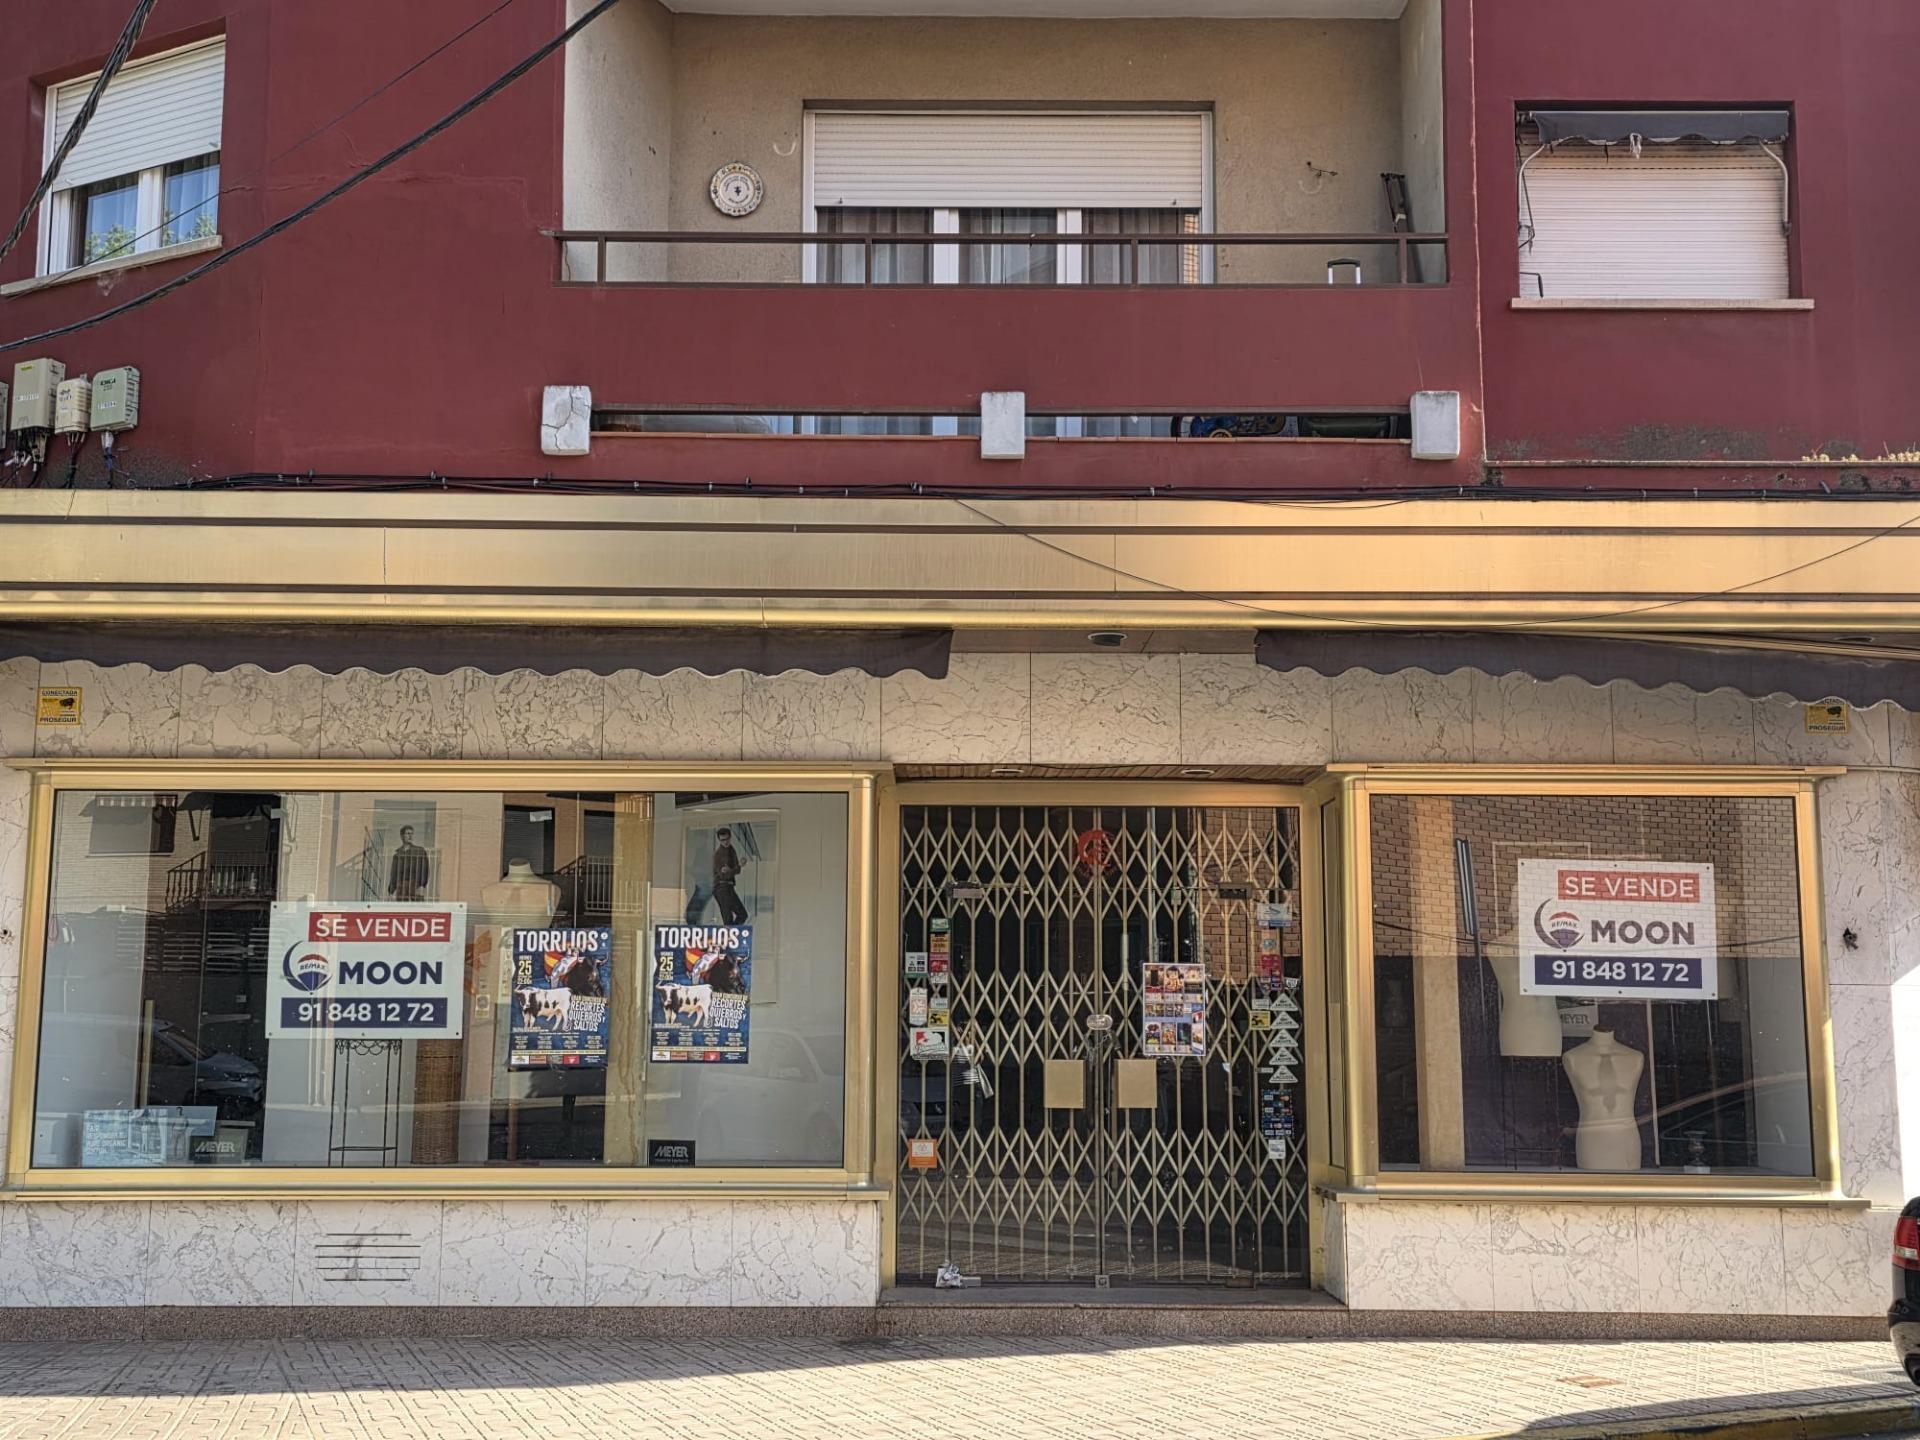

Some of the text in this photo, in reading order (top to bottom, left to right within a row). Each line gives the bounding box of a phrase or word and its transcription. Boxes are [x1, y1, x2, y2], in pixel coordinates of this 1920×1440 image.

[1565, 876, 1694, 898] SE VENDE
[315, 918, 446, 937] SE VENDE
[1551, 920, 1578, 929] RE/MAX
[1591, 919, 1695, 945] MOON
[300, 962, 326, 971] RE/MAX
[518, 960, 532, 975] 25
[660, 956, 674, 971] 25
[1552, 960, 1690, 982] 91 848 12 72
[338, 961, 443, 985] MOON
[298, 1003, 434, 1022] 91 848 12 72
[573, 1020, 599, 1032] SALTOS
[714, 1017, 739, 1029] SALTOS
[195, 1141, 236, 1153] MEYER
[654, 1145, 689, 1158] MEYER
